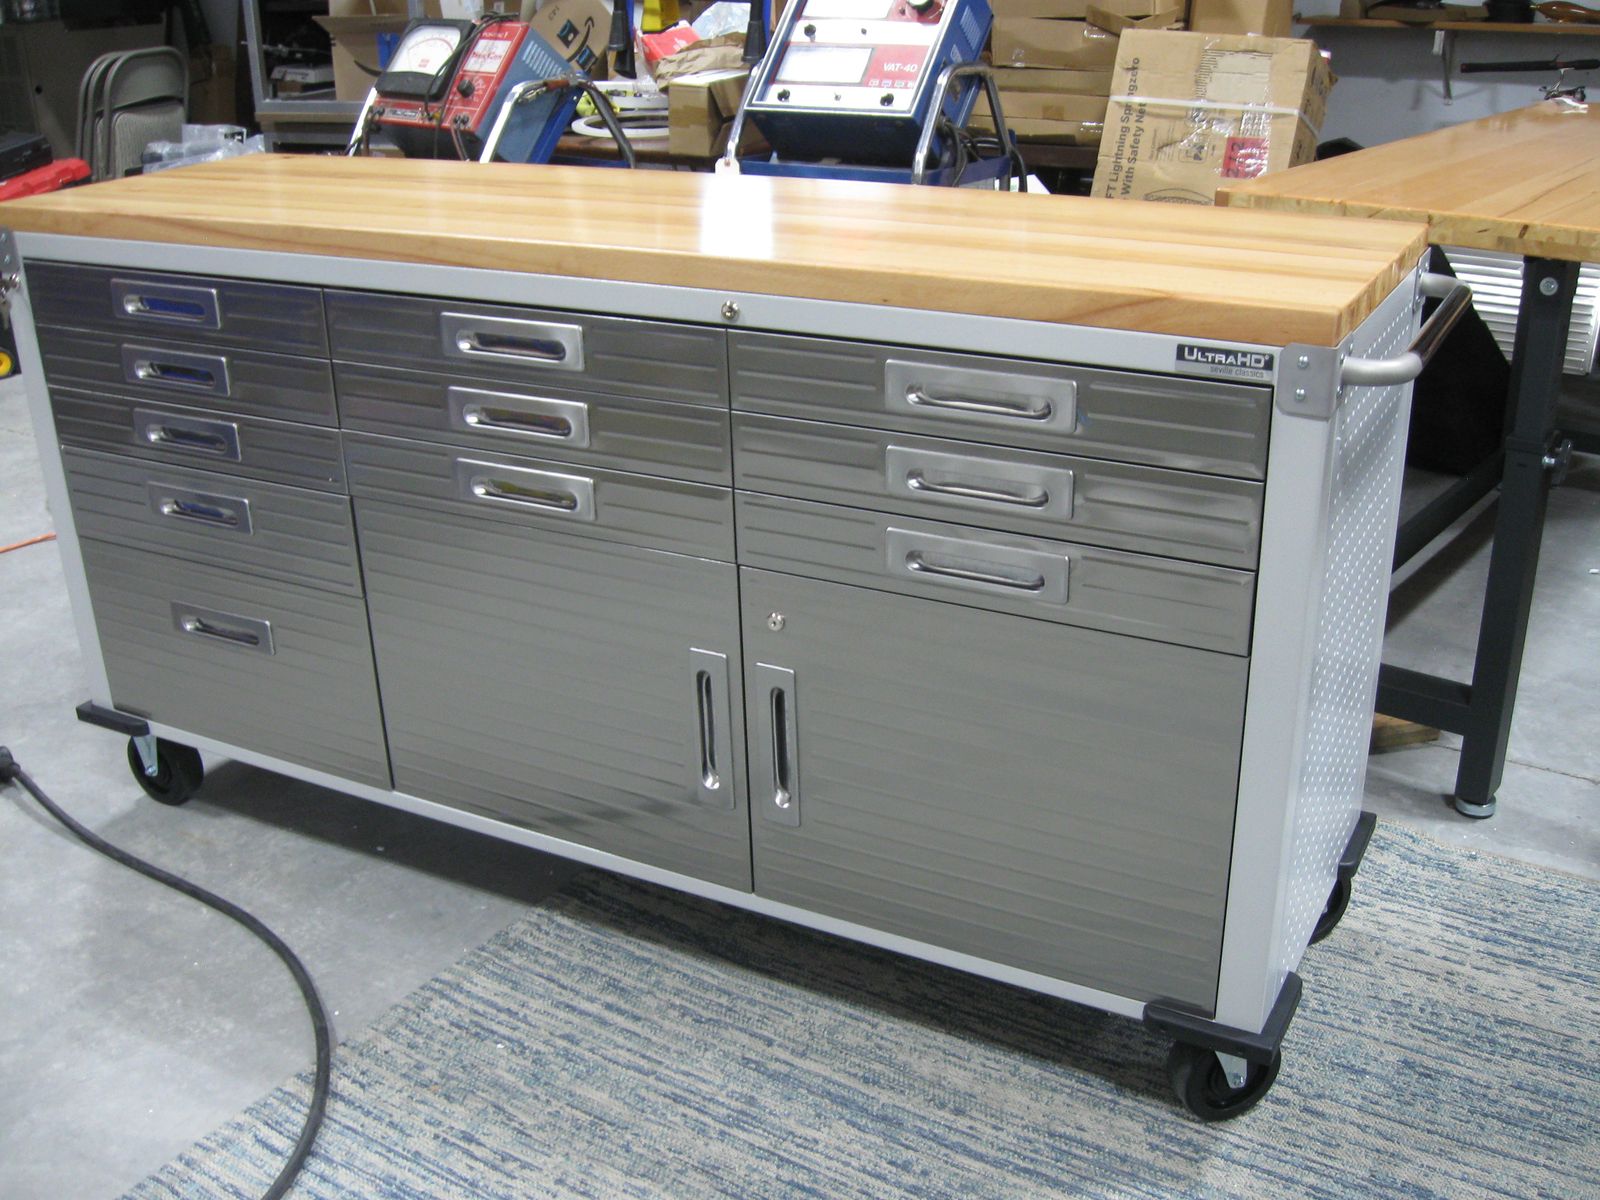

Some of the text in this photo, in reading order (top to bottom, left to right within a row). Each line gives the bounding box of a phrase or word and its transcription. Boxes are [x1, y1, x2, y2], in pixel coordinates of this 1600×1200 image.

[883, 63, 918, 72] VAT-40
[1108, 128, 1131, 184] Lightning
[1120, 57, 1140, 124] Sprngzero
[1120, 103, 1148, 195] With Safety Net
[1234, 368, 1265, 378] classics
